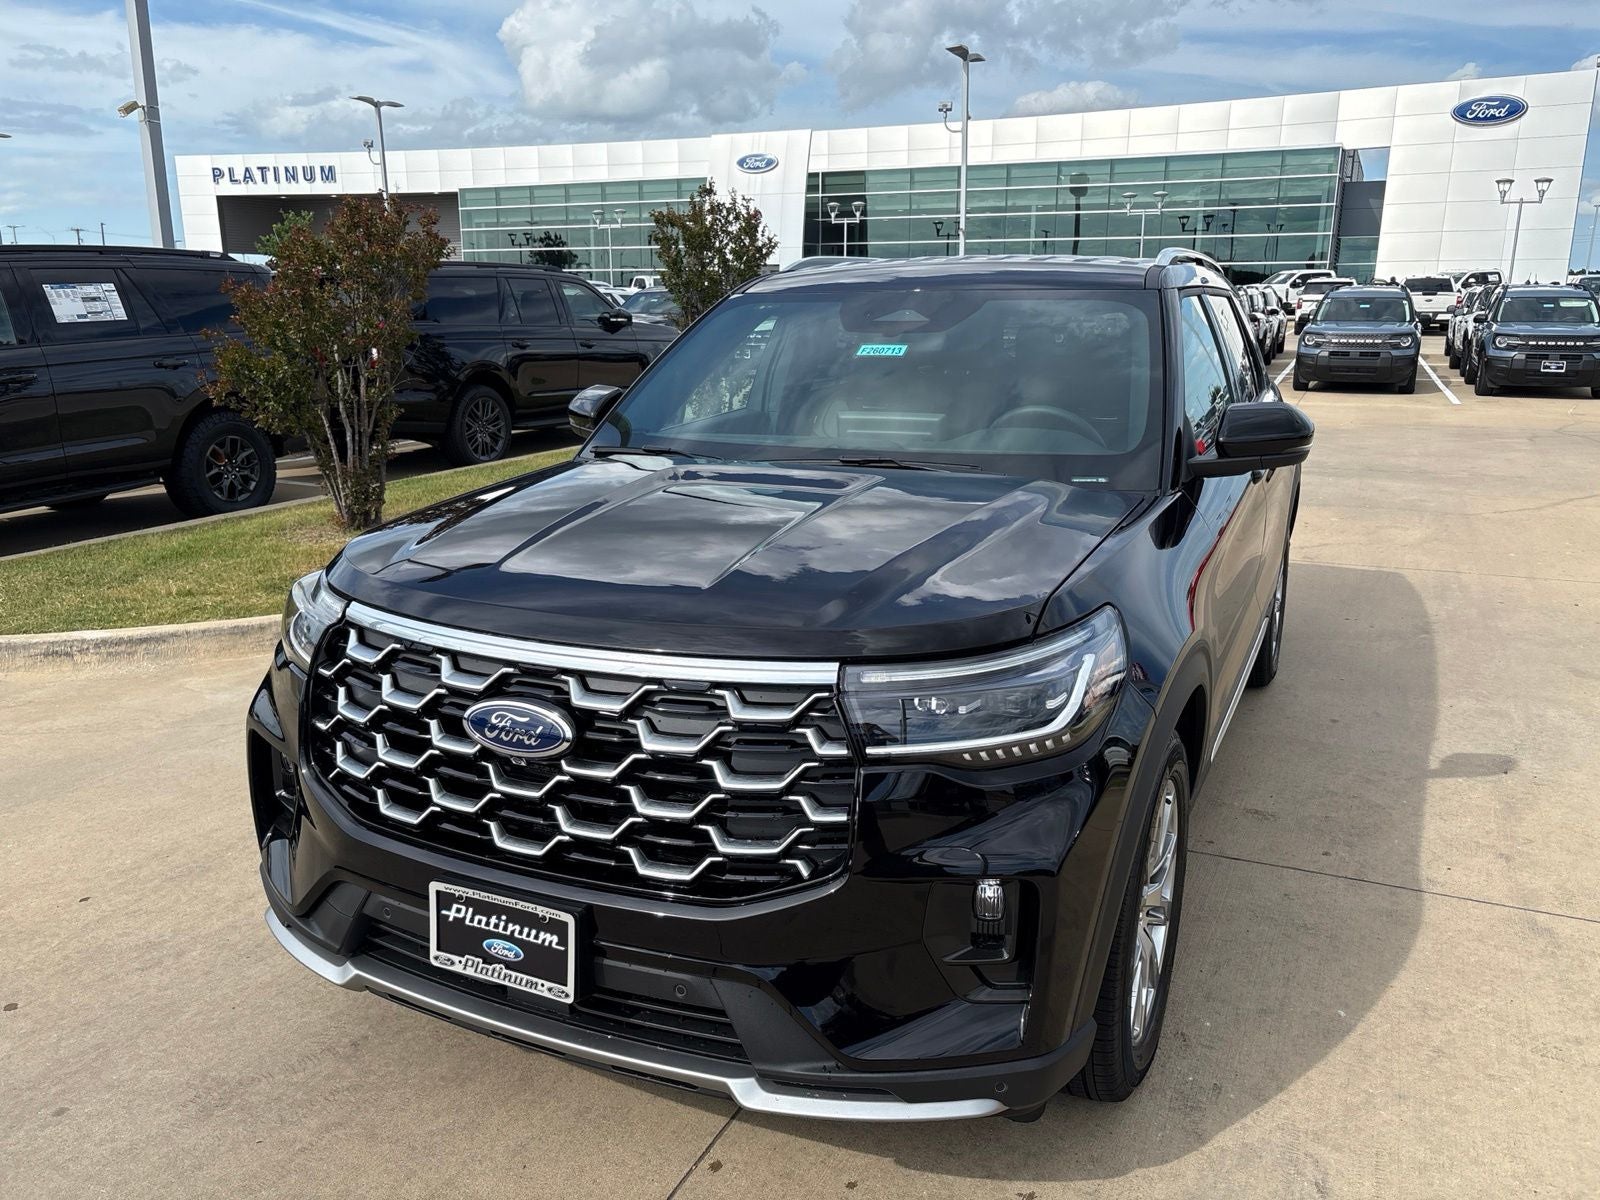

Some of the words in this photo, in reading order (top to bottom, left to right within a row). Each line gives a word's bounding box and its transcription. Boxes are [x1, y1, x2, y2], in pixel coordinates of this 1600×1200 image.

[1466, 100, 1510, 118] Ford
[743, 157, 768, 168] Ford
[211, 165, 337, 185] PLATINUM
[860, 347, 903, 355] F260713
[484, 711, 543, 746] Ford
[443, 885, 562, 919] www.PlatinumFord.com
[441, 903, 566, 951] Platinum
[490, 942, 516, 959] Ford
[462, 957, 545, 992] Platinum
